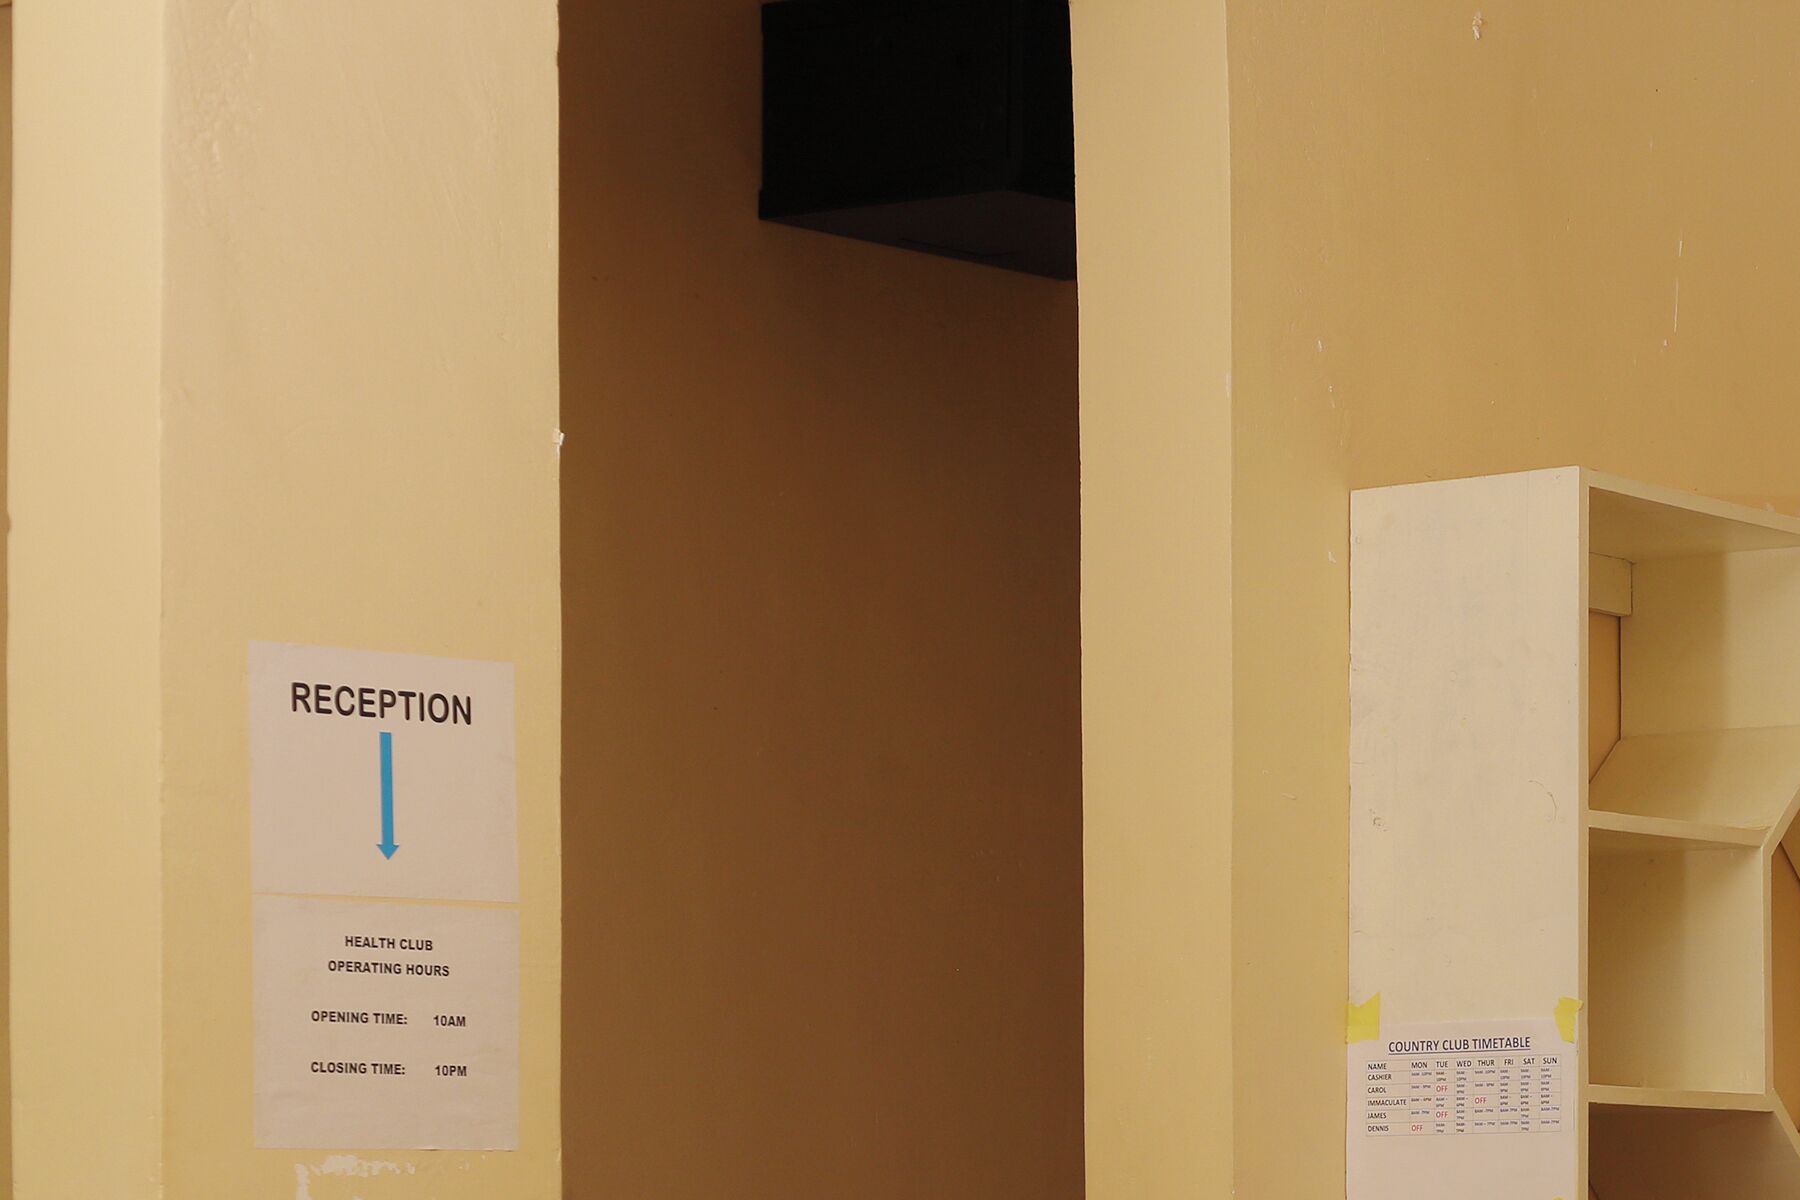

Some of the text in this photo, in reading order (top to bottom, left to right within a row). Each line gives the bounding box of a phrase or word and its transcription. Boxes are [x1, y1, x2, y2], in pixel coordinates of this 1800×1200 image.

[291, 682, 472, 724] RECEPTION
[345, 936, 433, 951] HEALTH CLUB
[328, 961, 450, 977] OPERATING HOURS
[311, 1011, 407, 1026] OPENING TIME:
[434, 1014, 466, 1027] 10AM
[1388, 1037, 1531, 1053] COUNTRY CLUB TIMETABLE
[311, 1062, 405, 1076] CLOSING TIME:
[435, 1065, 467, 1077] 10PM
[1367, 1062, 1387, 1070] NAME
[1478, 1059, 1495, 1067] THUR
